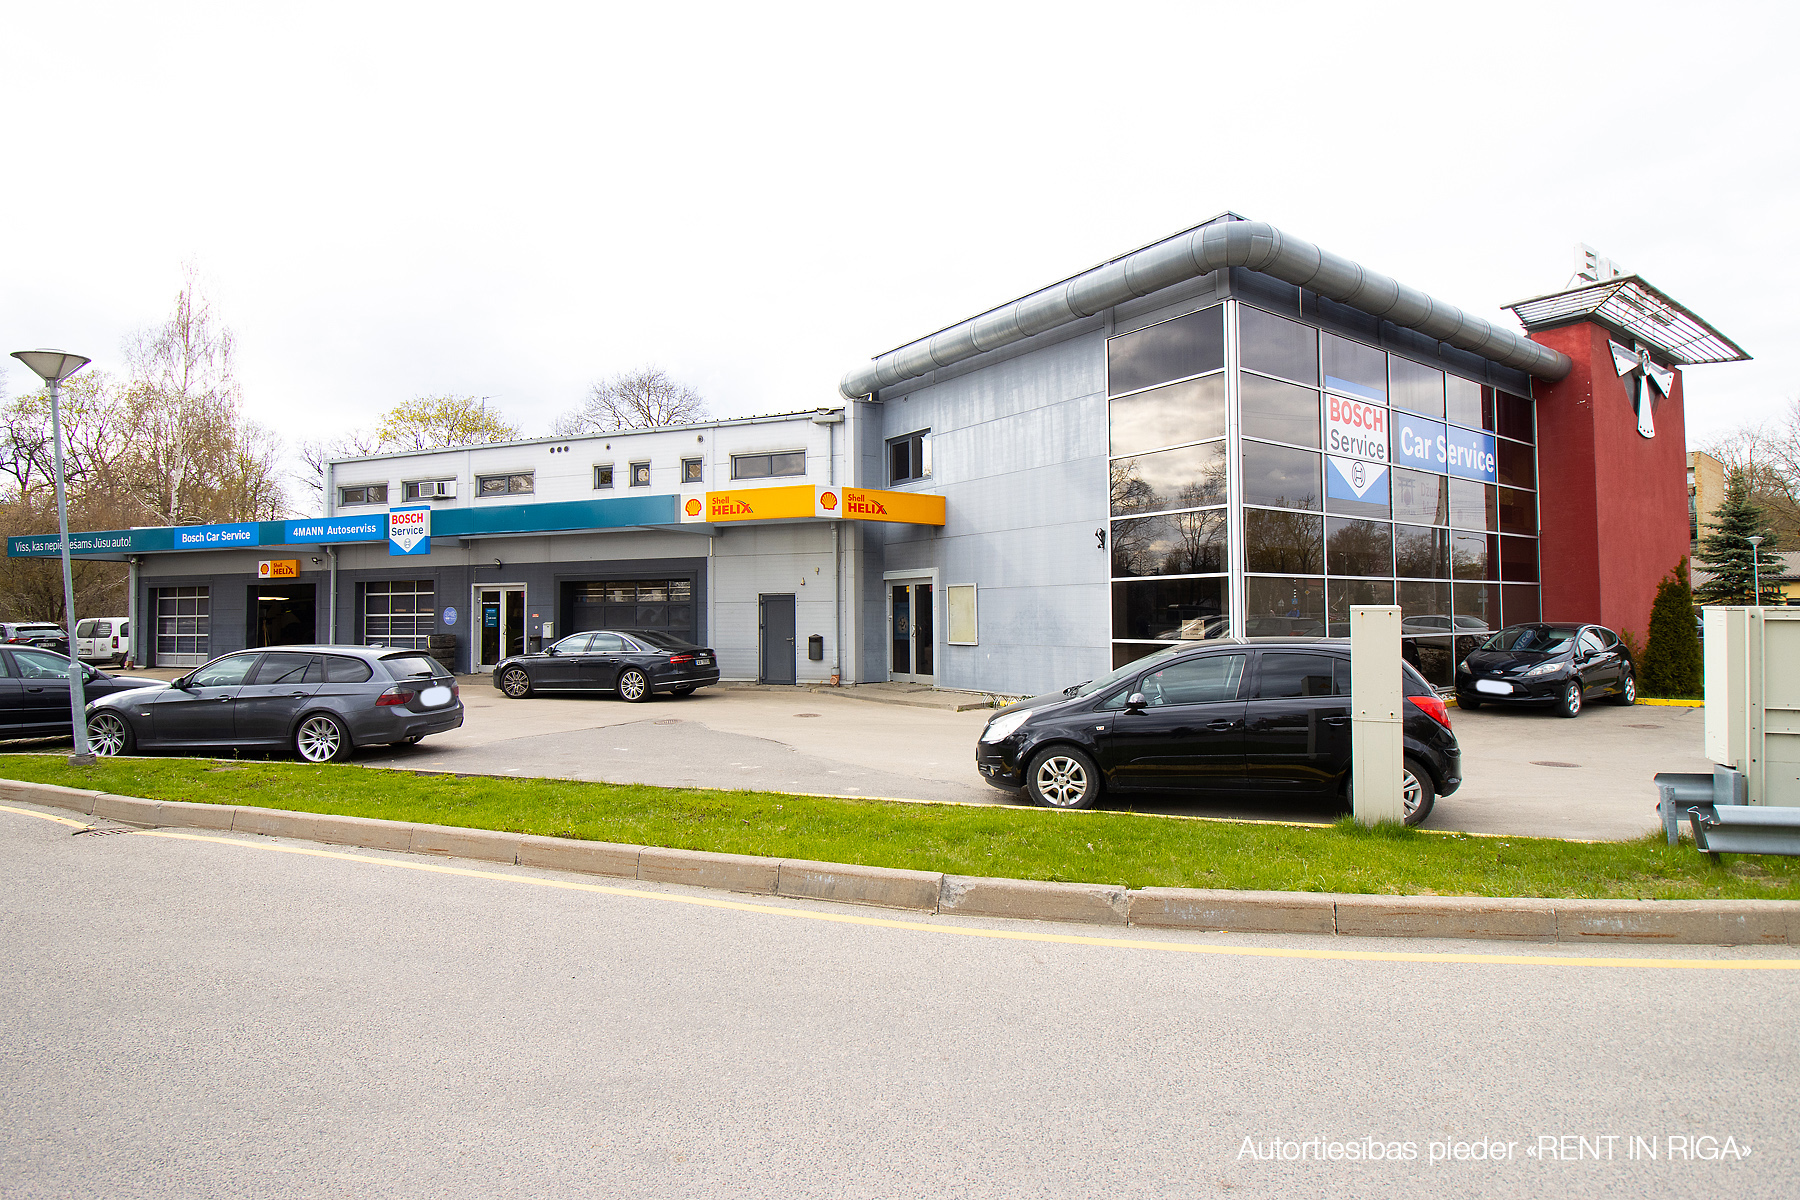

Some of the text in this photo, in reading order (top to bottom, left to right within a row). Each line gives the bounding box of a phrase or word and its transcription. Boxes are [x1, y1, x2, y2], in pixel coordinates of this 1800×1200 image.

[1330, 397, 1383, 432] BOSCH
[1330, 429, 1385, 459] Service
[1401, 427, 1494, 473] Car Service
[712, 496, 730, 505] Shell
[847, 493, 866, 502] Shell
[712, 503, 751, 516] HELIX
[847, 501, 886, 515] HELIX
[391, 512, 424, 525] BOSCH
[182, 530, 251, 543] Bosch Car Service
[293, 523, 377, 537] 4MANN Autoserviss
[391, 525, 424, 536] Service
[15, 536, 132, 553] Viss, kas nepieešams Jūsu auto!
[273, 567, 294, 575] HELIX
